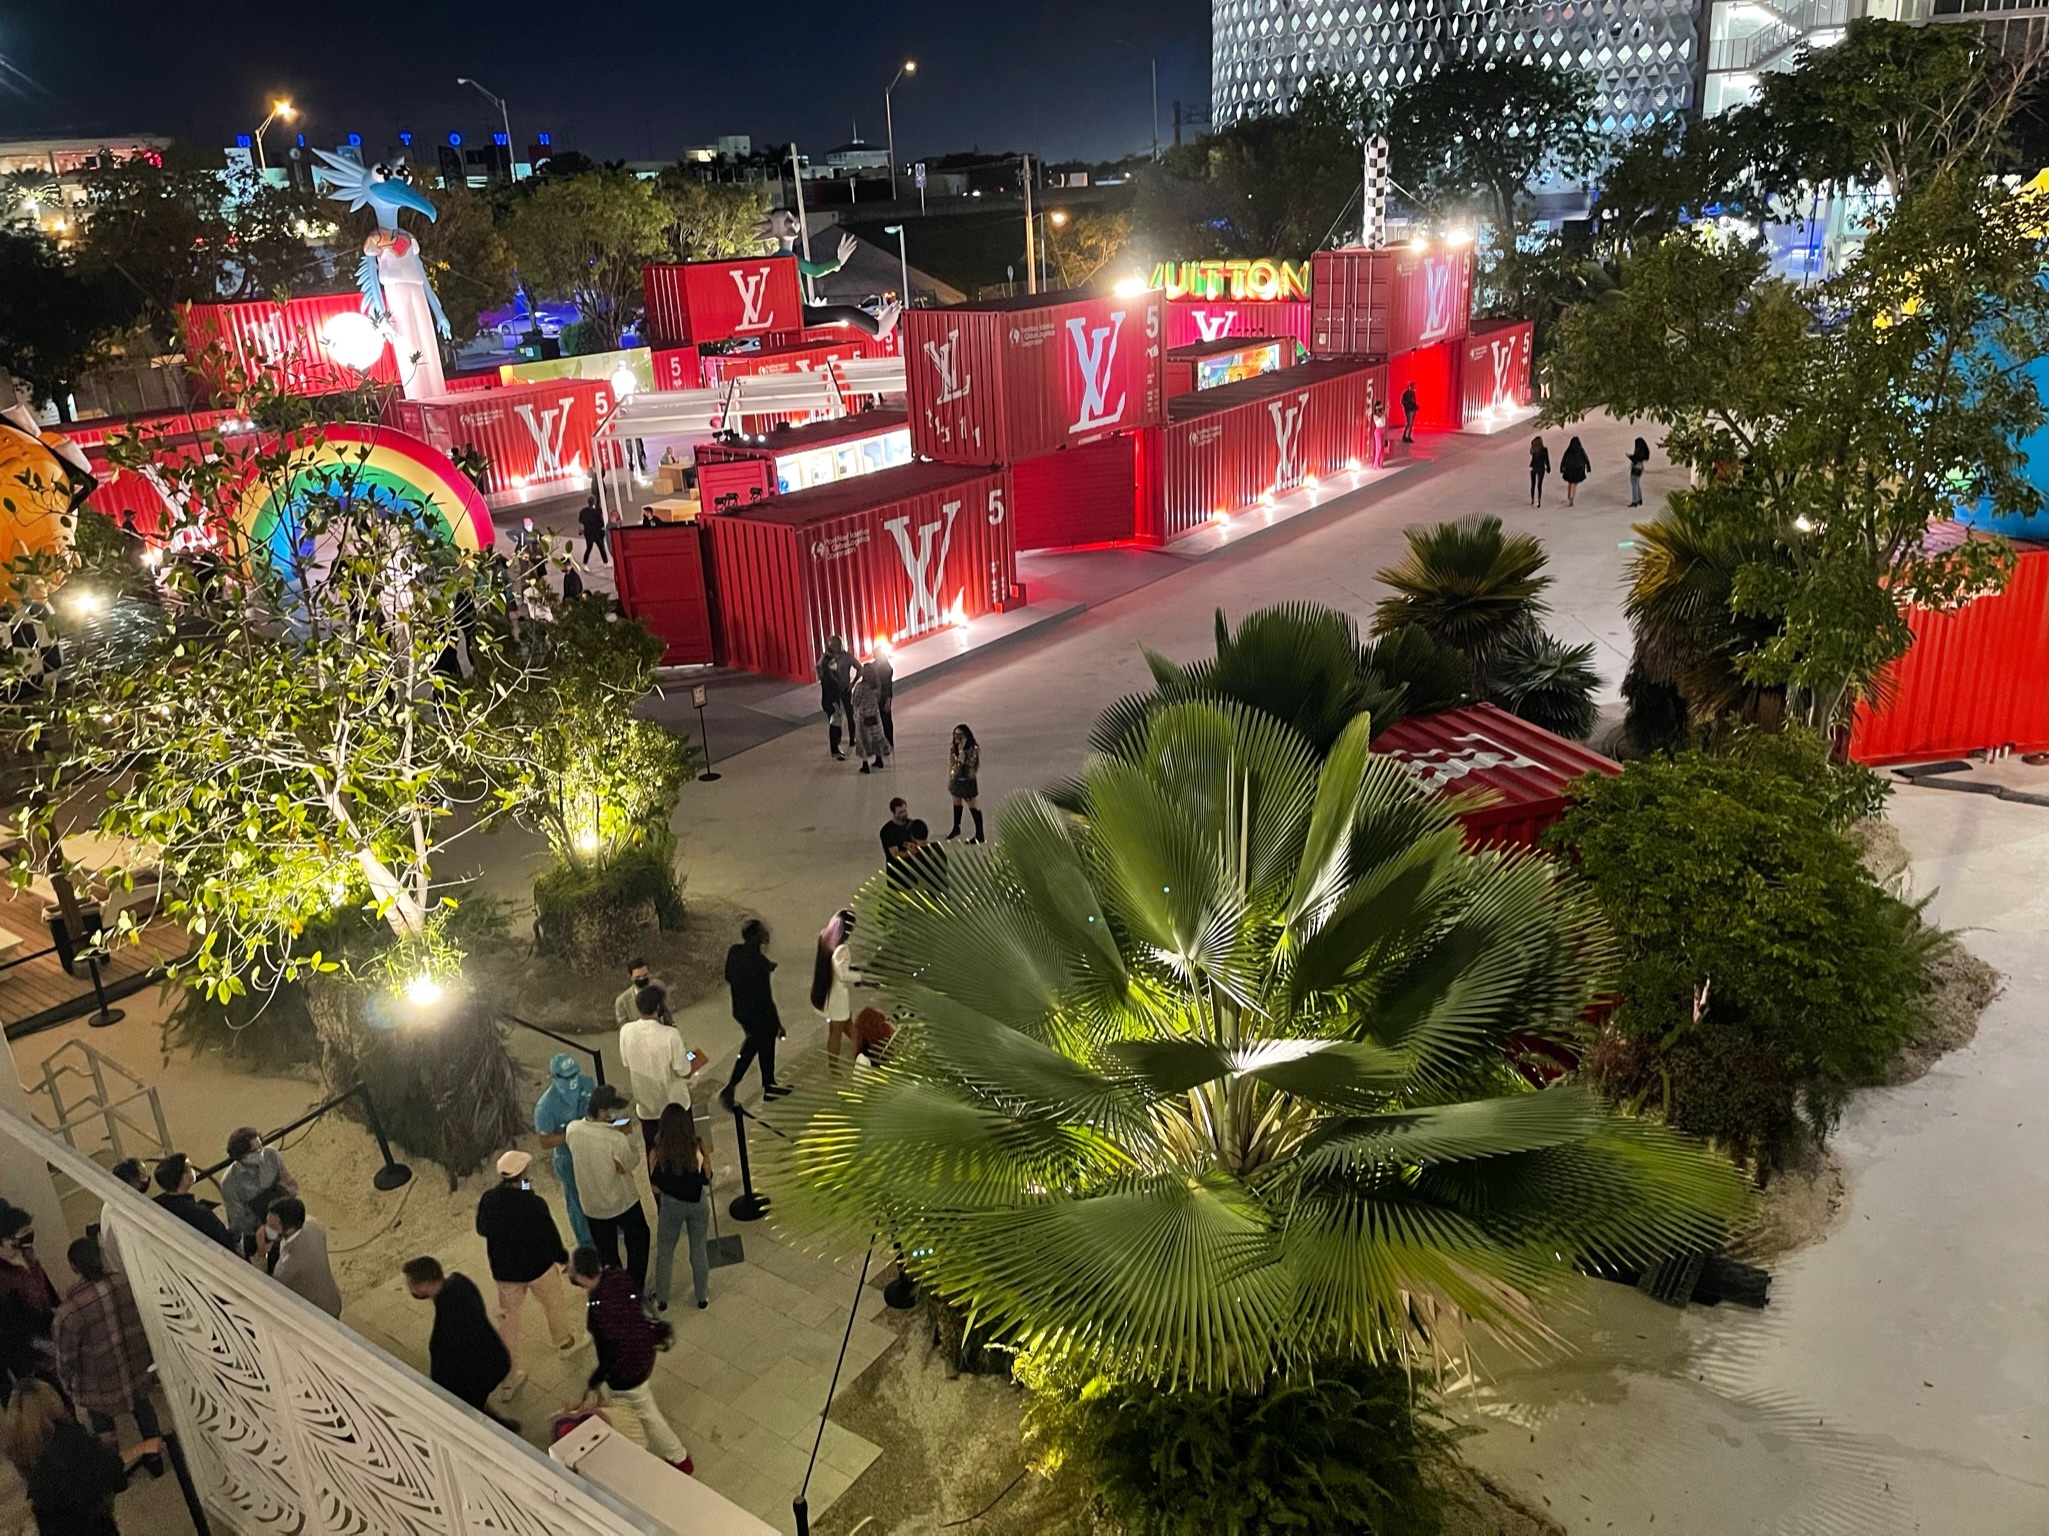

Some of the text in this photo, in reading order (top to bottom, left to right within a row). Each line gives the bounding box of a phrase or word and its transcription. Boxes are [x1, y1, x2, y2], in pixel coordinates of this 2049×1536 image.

[236, 132, 550, 147] MIDTOWN
[729, 267, 774, 331] LV
[1146, 305, 1159, 339] 5
[670, 357, 681, 377] 5
[924, 329, 971, 405] LV
[1066, 311, 1126, 433] LV
[595, 392, 608, 415] 5
[988, 488, 1005, 526] 5
[883, 500, 964, 642] LV
